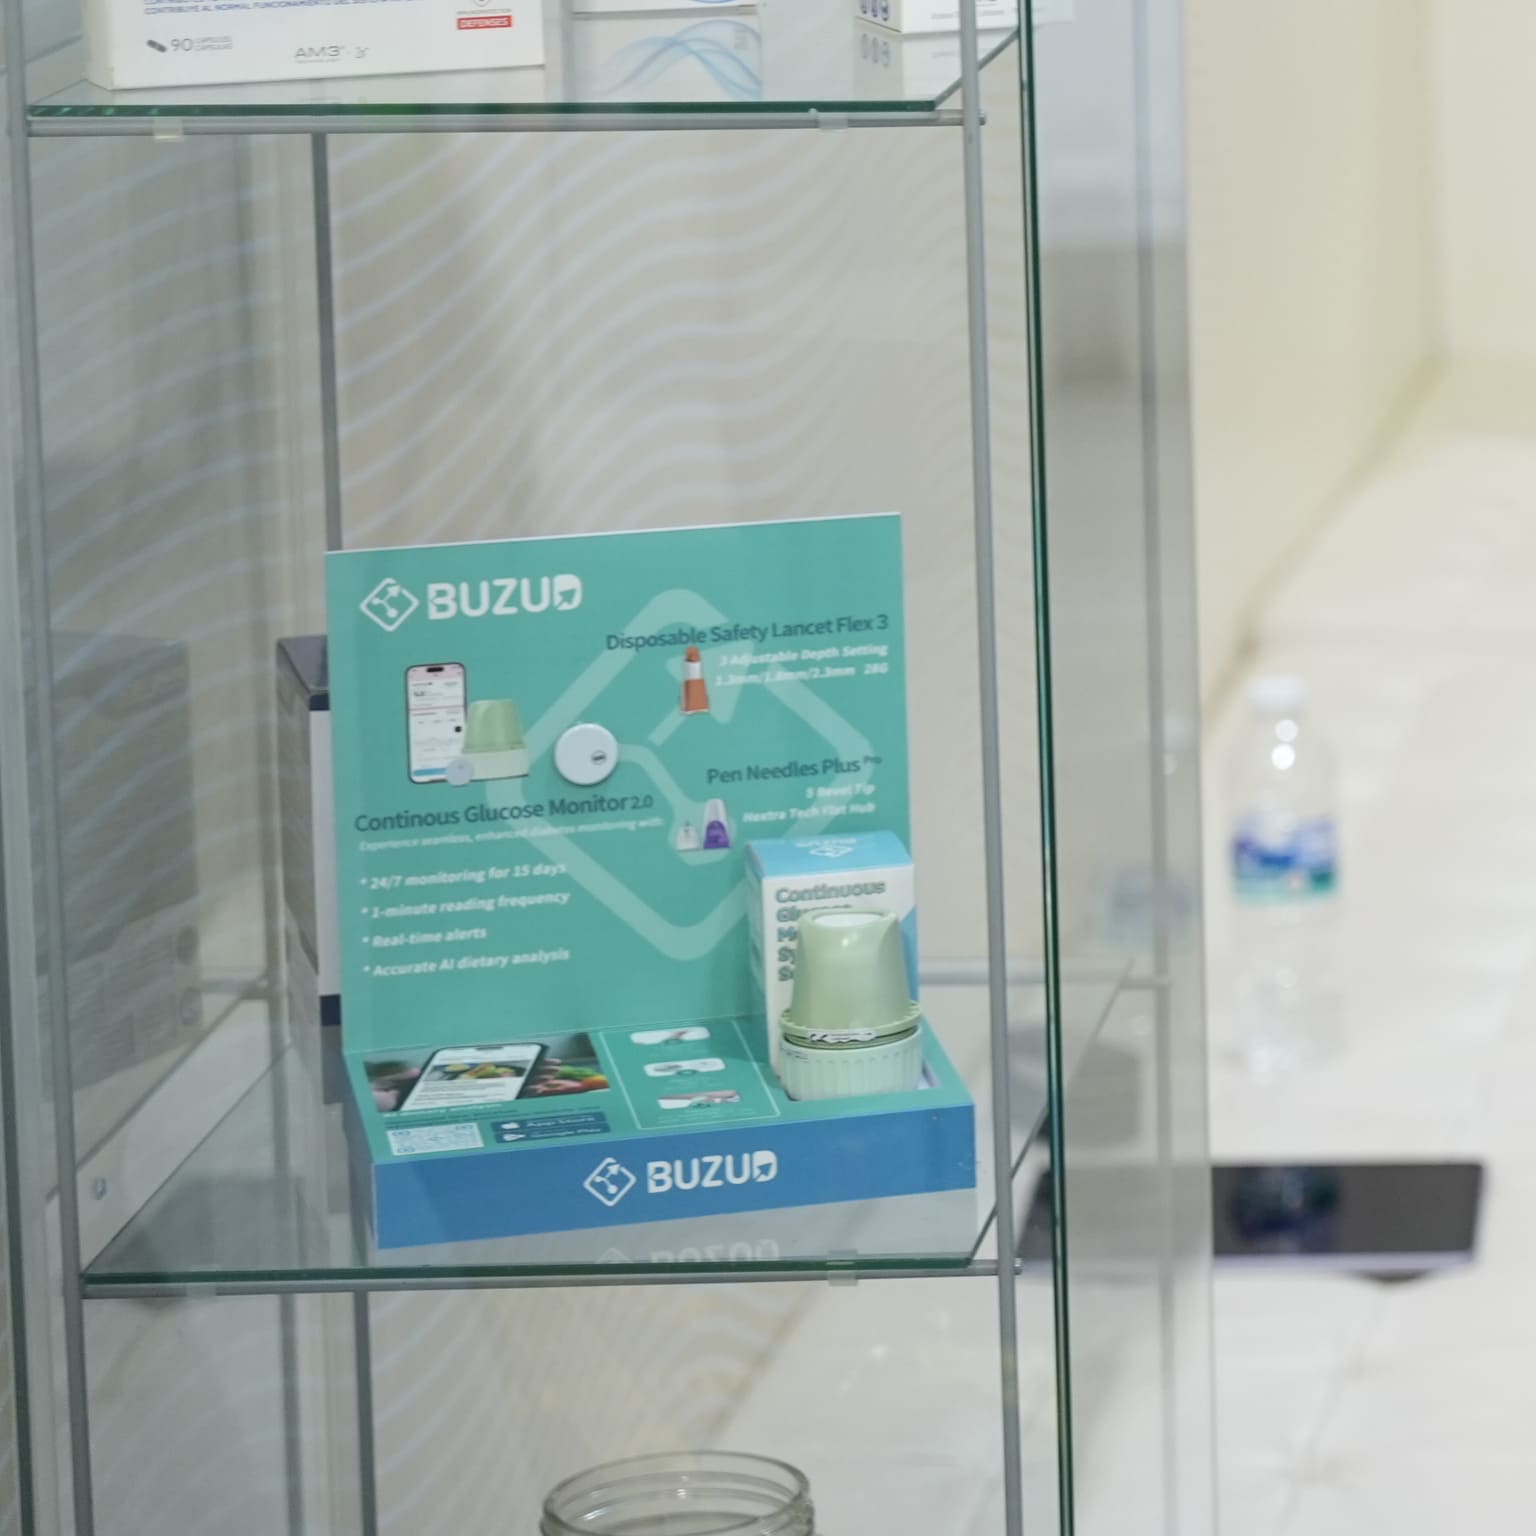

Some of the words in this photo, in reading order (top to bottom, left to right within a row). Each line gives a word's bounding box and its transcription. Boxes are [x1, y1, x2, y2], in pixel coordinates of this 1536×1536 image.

[170, 38, 194, 52] 90
[427, 573, 583, 620] BUZUD
[606, 627, 706, 652] Disposable
[710, 622, 769, 644] Safety
[772, 617, 834, 638] Lancet
[836, 615, 873, 634] Flex
[877, 613, 889, 631] 3
[730, 649, 799, 667] Adjustable
[801, 646, 840, 661] Depth
[842, 643, 889, 659] Setting
[707, 768, 743, 784] Pen
[746, 761, 819, 782] Needles
[822, 757, 862, 775] Plus
[863, 755, 883, 765] Pro
[354, 808, 461, 833] Continous
[464, 800, 545, 824] Glucose
[548, 794, 628, 816] Monitor
[630, 794, 655, 811] 2.0
[370, 875, 403, 891] 24/7
[404, 869, 486, 886] monitoring
[488, 866, 511, 880] for
[513, 865, 531, 878] 15
[532, 863, 568, 878] days
[371, 903, 437, 919] 1-minute
[439, 896, 496, 913] reading
[498, 891, 571, 909] frequency
[775, 881, 887, 904] Continuous
[372, 931, 443, 948] Real-time
[445, 927, 488, 943] alerts
[372, 961, 438, 977] Accurate
[439, 958, 454, 972] AI
[457, 954, 510, 970] dietary
[511, 948, 571, 966] analysis
[646, 1149, 779, 1194] BUZUD
